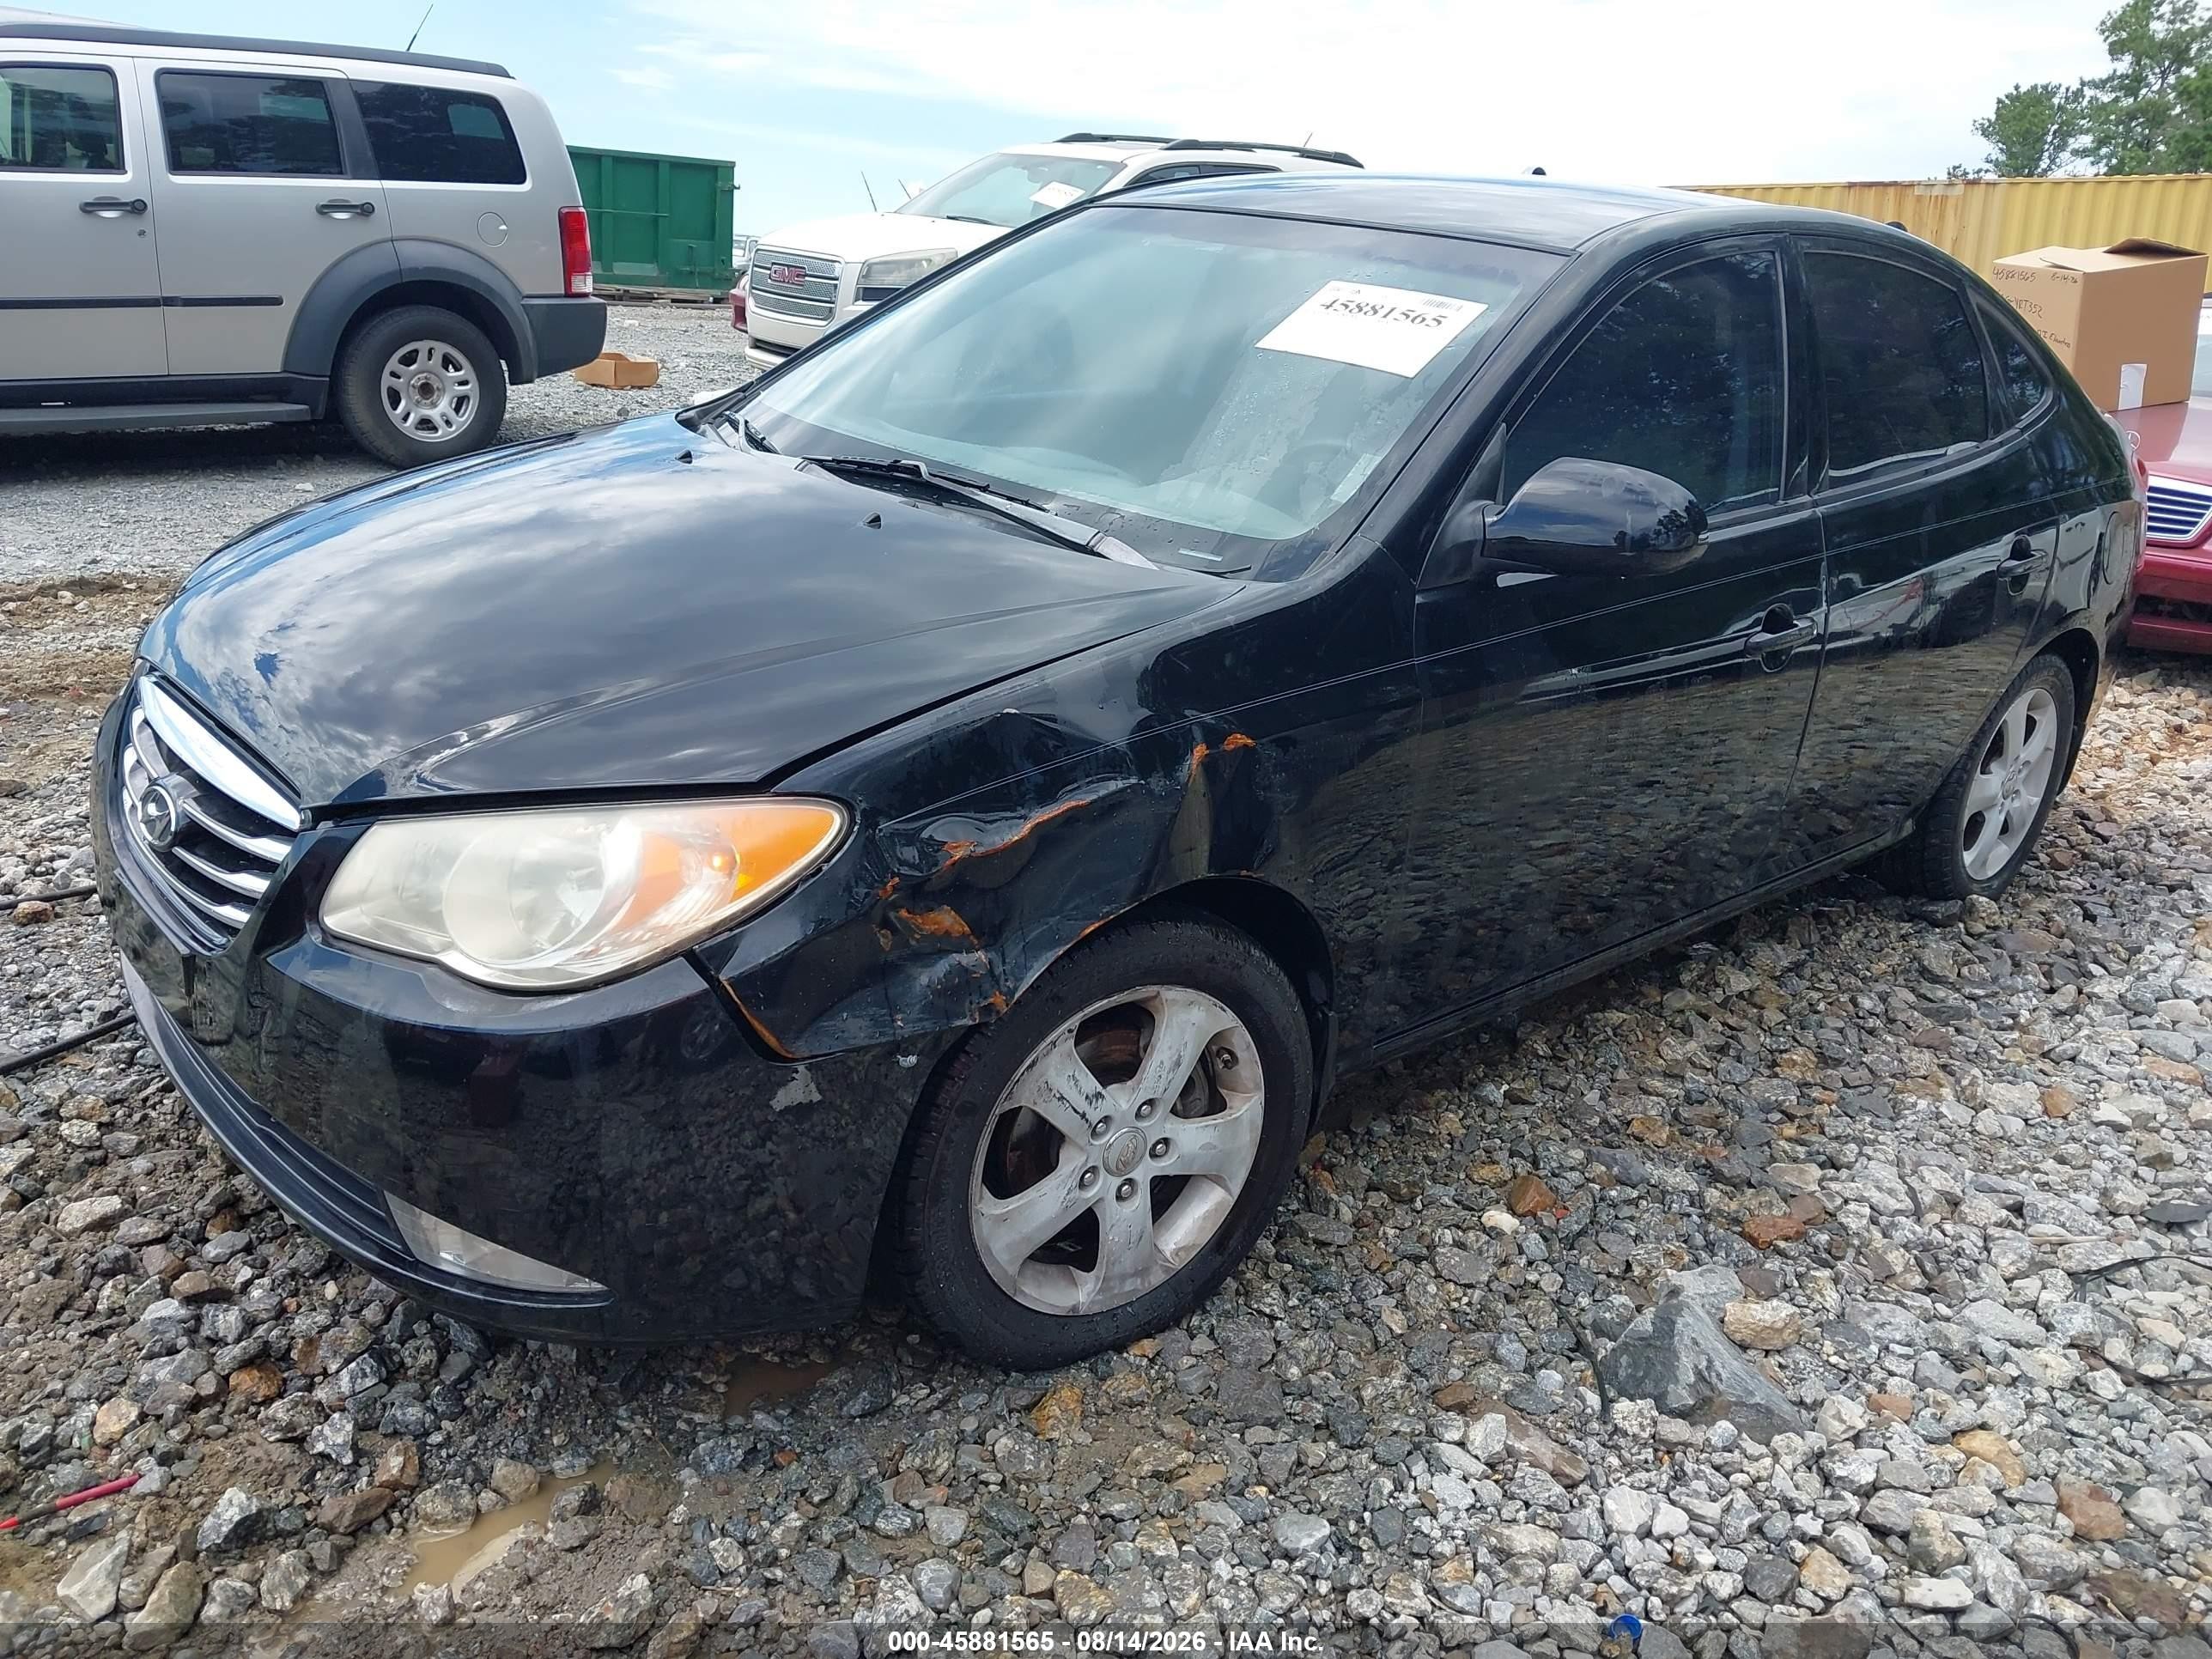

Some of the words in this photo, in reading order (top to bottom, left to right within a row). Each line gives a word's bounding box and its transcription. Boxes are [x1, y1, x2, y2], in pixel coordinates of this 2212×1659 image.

[770, 264, 805, 285] GMC
[1992, 266, 2037, 283] 45881565
[1320, 298, 1448, 328] 45881565
